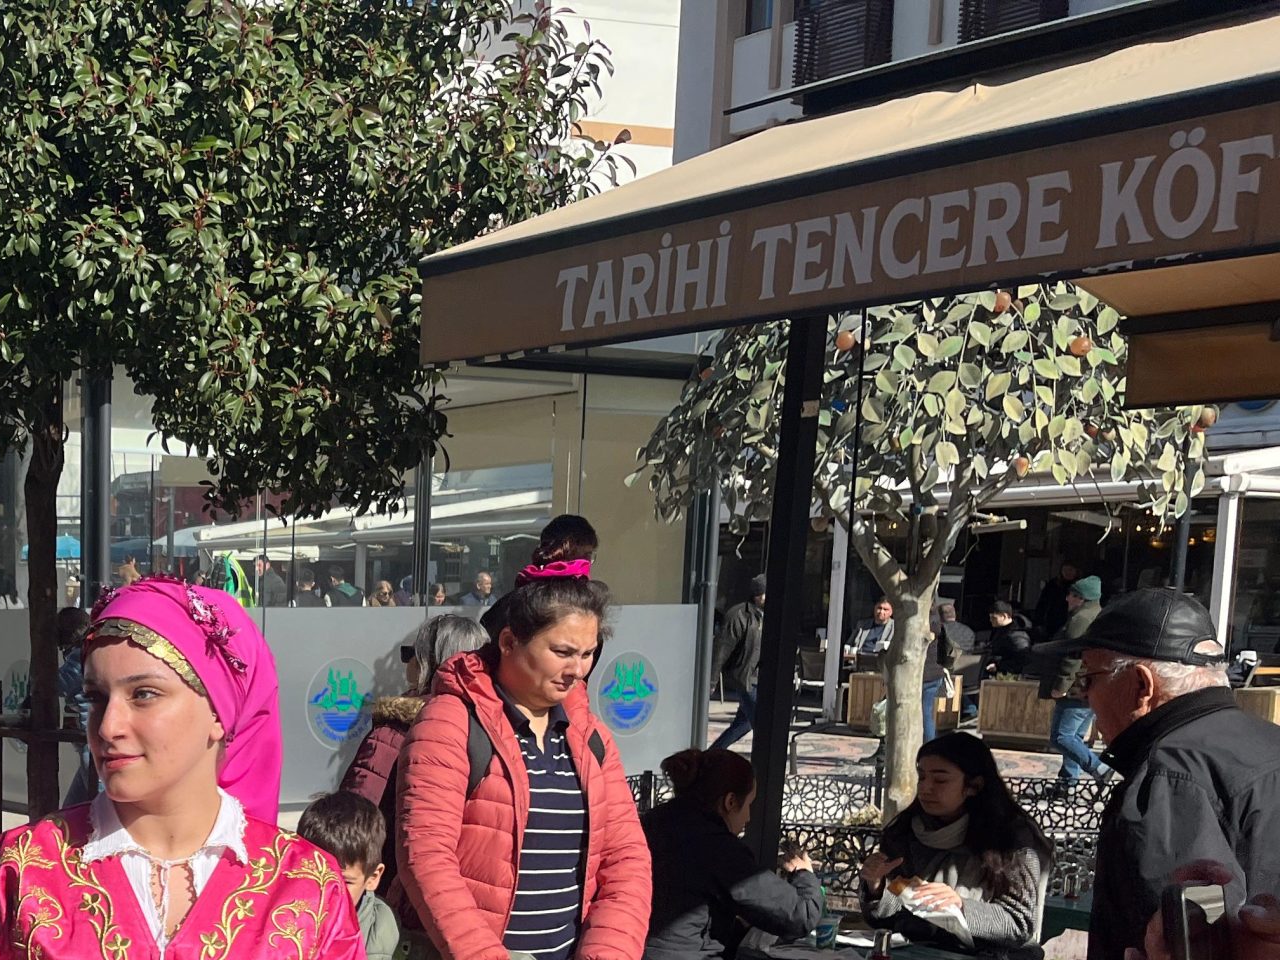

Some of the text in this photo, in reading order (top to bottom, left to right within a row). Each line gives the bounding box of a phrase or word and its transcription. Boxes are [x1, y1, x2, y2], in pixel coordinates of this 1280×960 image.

[555, 126, 1280, 333] TARİHİ TENCERE KÖF
